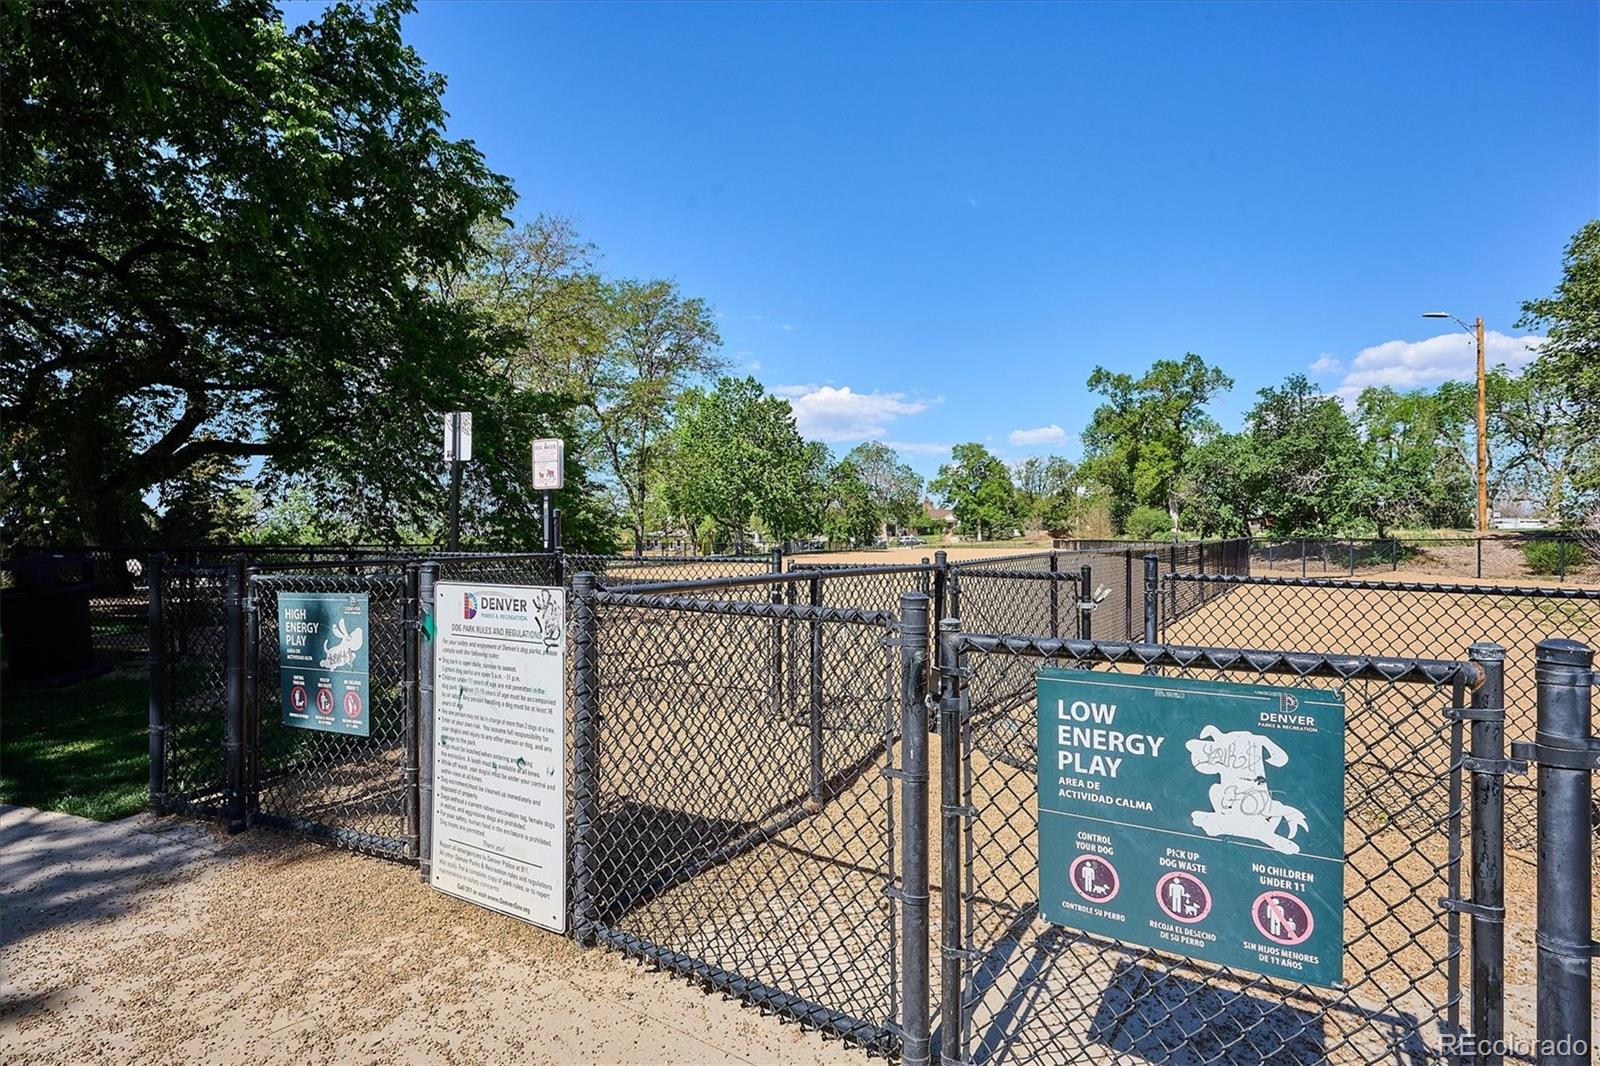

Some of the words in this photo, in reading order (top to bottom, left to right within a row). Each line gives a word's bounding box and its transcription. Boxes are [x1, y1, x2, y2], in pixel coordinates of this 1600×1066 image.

[481, 596, 527, 612] DENVER
[285, 608, 306, 620] HIGH
[499, 613, 528, 621] RECREATION
[286, 622, 319, 633] ENERGY
[451, 623, 462, 632] DOG
[462, 624, 475, 632] PARK
[475, 625, 492, 635] RULES
[492, 627, 503, 636] AND
[504, 628, 542, 640] REGULATIONS
[286, 634, 306, 646] PLAY
[1058, 700, 1116, 724] LOW
[1260, 712, 1315, 726] DENVER
[1283, 725, 1318, 733] RECREATION
[1058, 725, 1164, 757] ENERGY
[1058, 750, 1122, 778] PLAY
[1058, 776, 1084, 788] AREA
[1087, 781, 1100, 790] DE
[1058, 789, 1113, 805] ACTIVIDAD
[1115, 798, 1153, 811] CALMA
[1077, 831, 1111, 845] CONTROL
[1075, 841, 1096, 852] YOUR
[1098, 845, 1113, 855] DOG
[1167, 848, 1186, 859] PICK
[1187, 852, 1199, 861] UP
[1160, 857, 1177, 868] DOG
[1179, 860, 1207, 874] WASTE
[1252, 863, 1265, 874] NO
[1267, 866, 1314, 883] CHILDREN
[1260, 876, 1292, 890] UNDER
[1294, 883, 1305, 892] 11
[1062, 901, 1093, 915] CONTROLE
[1094, 909, 1103, 917] SU
[1104, 911, 1126, 922] PERRO
[1150, 920, 1174, 932] RECOJA
[1175, 926, 1184, 934] EL
[1185, 927, 1216, 941] DESECHO
[1160, 931, 1169, 940] DE
[1170, 934, 1179, 942] SU
[1181, 936, 1204, 947] PERRO
[1243, 942, 1256, 951] SIN
[1258, 944, 1280, 955] HIJOS
[1281, 949, 1319, 964] MENORES
[1259, 954, 1268, 962] DE
[1270, 956, 1280, 965] 11
[1281, 958, 1302, 970] AÑOS
